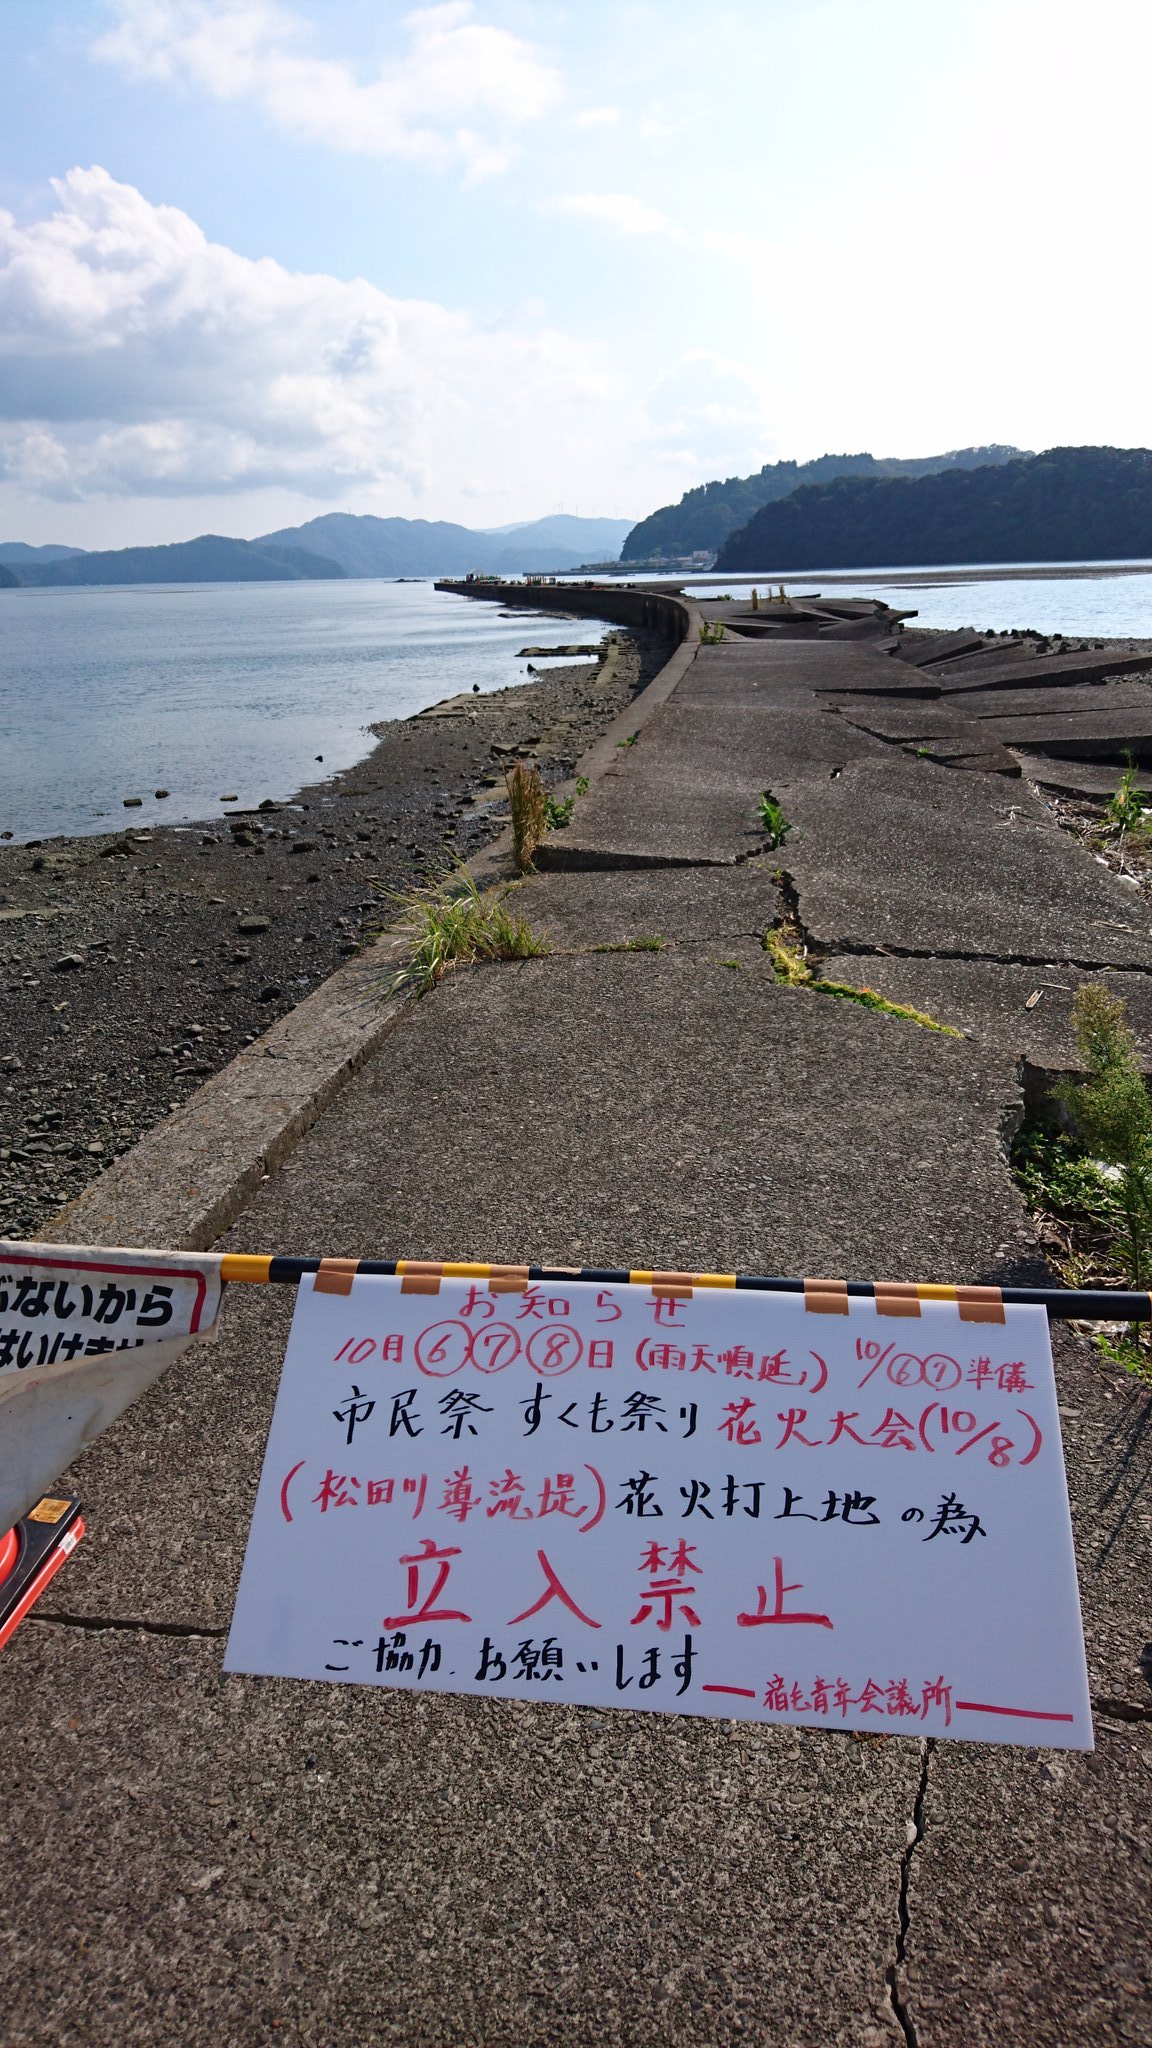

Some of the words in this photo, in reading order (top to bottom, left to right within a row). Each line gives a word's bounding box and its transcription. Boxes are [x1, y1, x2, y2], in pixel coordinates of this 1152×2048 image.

[459, 1284, 687, 1327] お知らせ
[333, 1385, 494, 1444] 市民祭
[519, 1382, 698, 1438] すくも祭り
[383, 1538, 834, 1632] 立入禁止
